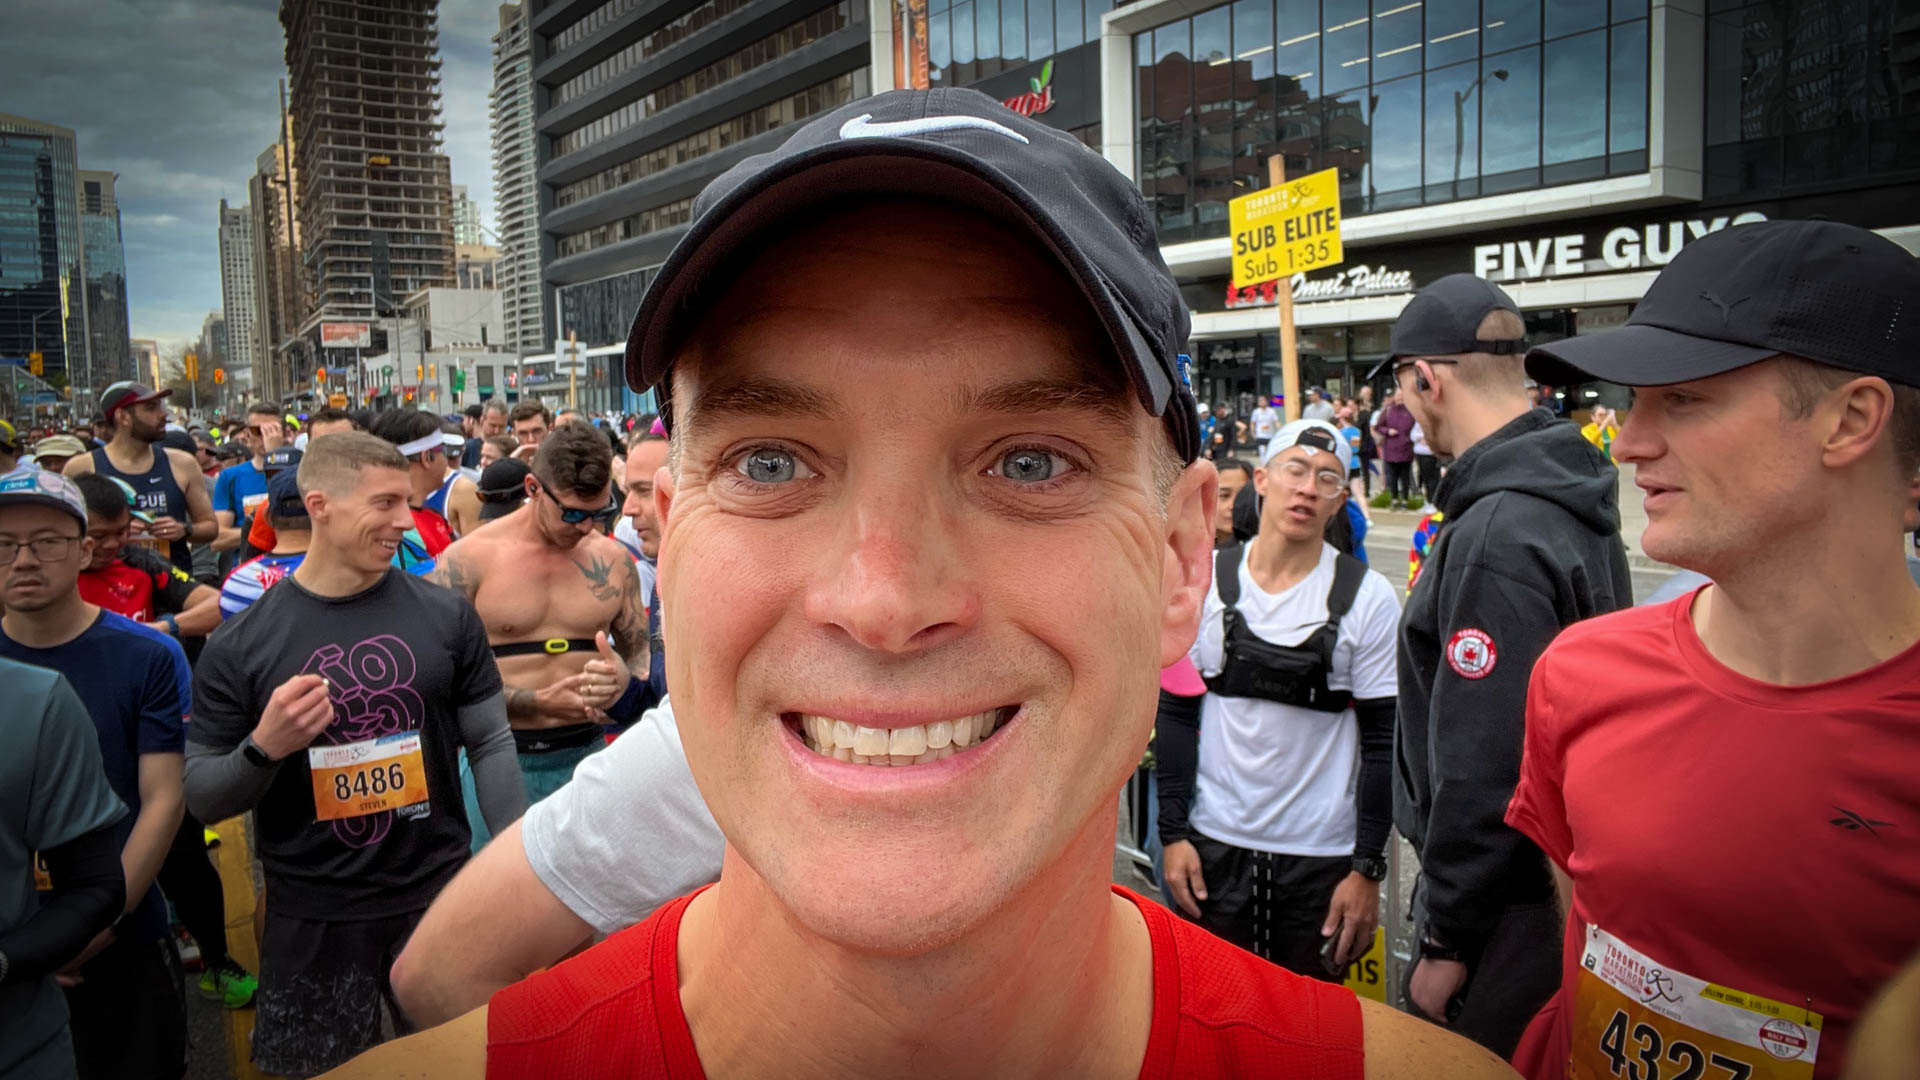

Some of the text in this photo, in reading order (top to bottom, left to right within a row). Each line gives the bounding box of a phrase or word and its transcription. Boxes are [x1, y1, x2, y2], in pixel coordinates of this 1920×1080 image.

[1237, 206, 1336, 256] SUB ELITE
[1244, 238, 1330, 281] Sub 1:35
[1475, 234, 1584, 280] FIVE
[1347, 264, 1412, 294] Palace
[334, 763, 406, 802] 8486
[359, 800, 388, 812] STEVEN
[1606, 943, 1647, 977] TORONTO
[1601, 1009, 1752, 1080] 4327
